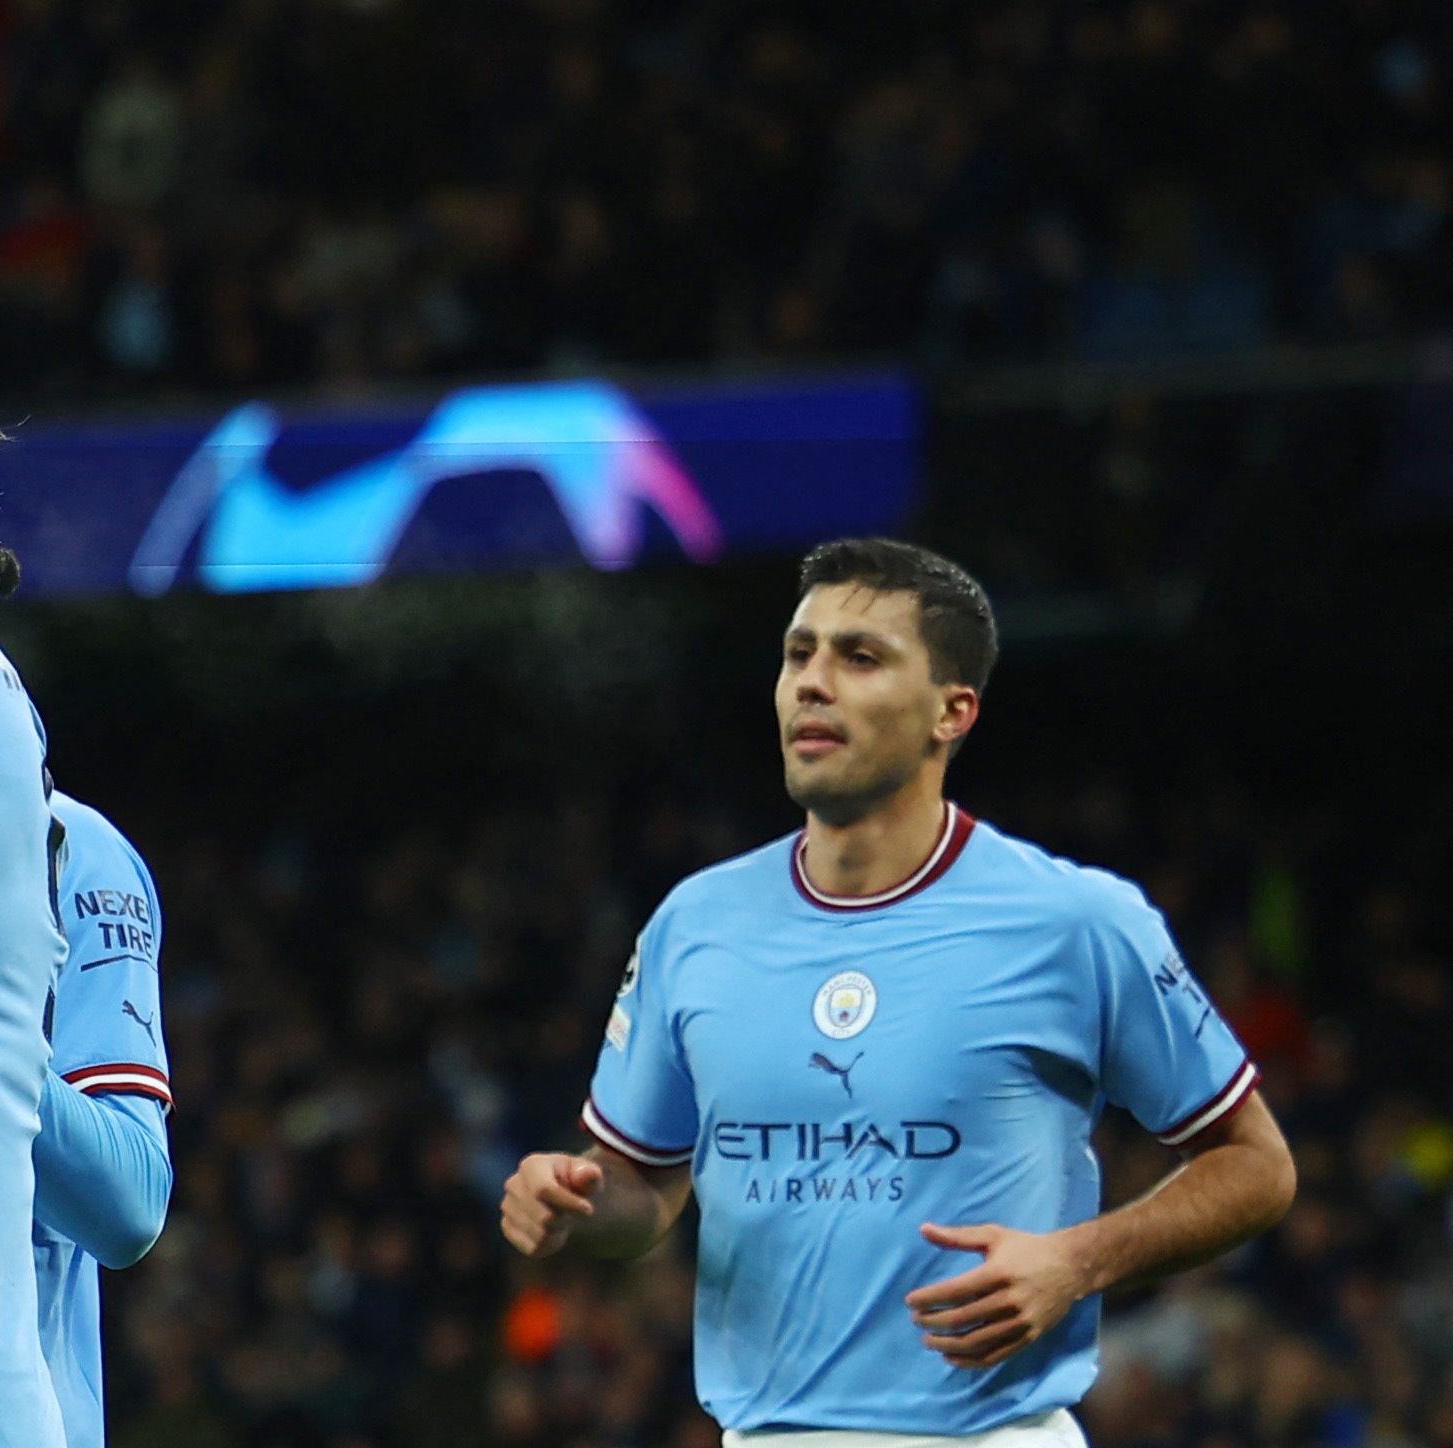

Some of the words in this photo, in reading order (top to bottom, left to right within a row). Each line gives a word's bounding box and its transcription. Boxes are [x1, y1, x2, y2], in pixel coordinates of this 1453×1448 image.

[74, 889, 151, 925] NEXE
[97, 921, 153, 960] TIRE
[715, 1120, 962, 1162] ETIHAD
[746, 1177, 904, 1203] AIRWAYS
